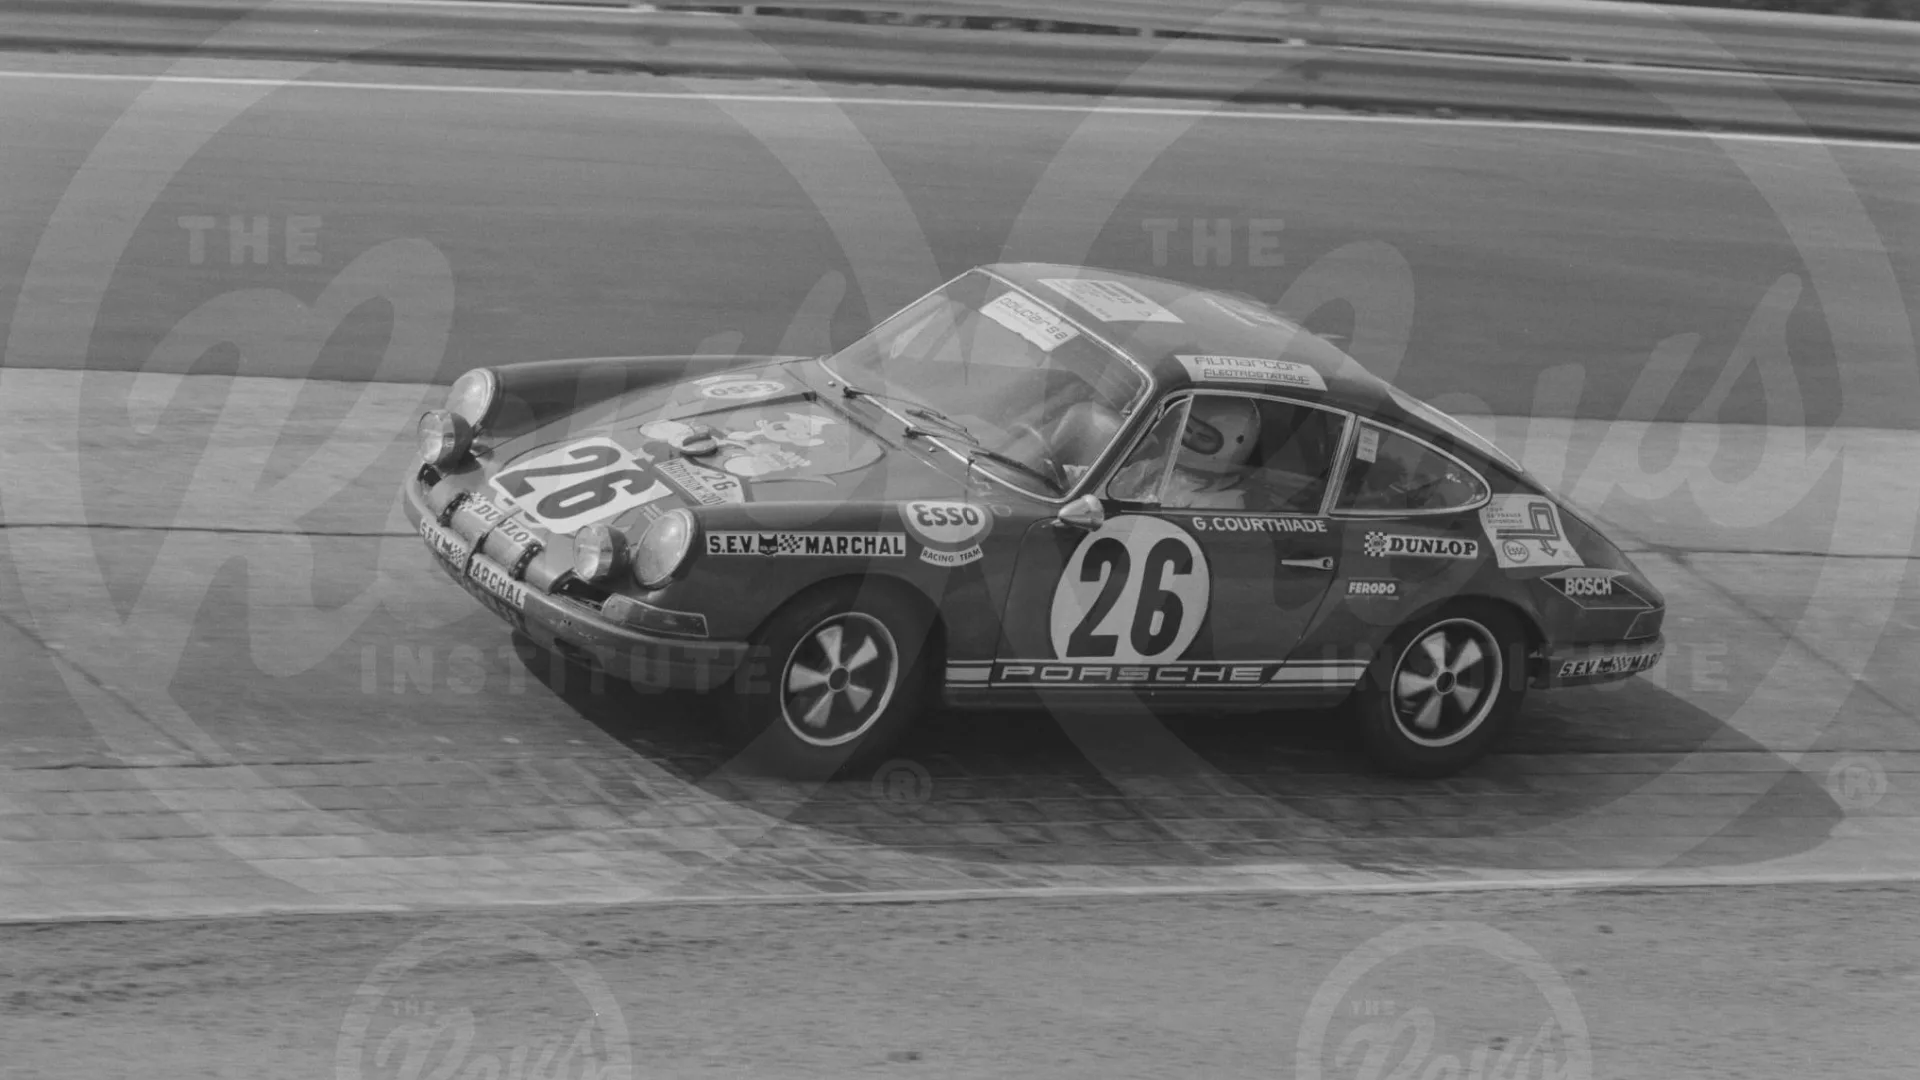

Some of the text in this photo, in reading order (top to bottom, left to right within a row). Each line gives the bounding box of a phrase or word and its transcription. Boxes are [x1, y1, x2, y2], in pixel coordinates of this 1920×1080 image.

[495, 445, 656, 520] 26
[704, 470, 738, 493] 26
[474, 503, 534, 545] DULO
[1192, 516, 1328, 533] G.COURTHIADE
[804, 535, 904, 555] MARCHAL
[1389, 536, 1477, 556] DUNLOP
[922, 548, 981, 564] RACING TEAM
[470, 558, 525, 608] ARCHAL
[1349, 581, 1396, 595] FERODO
[1564, 577, 1612, 596] BOSCH
[1065, 536, 1194, 657] 26
[1000, 665, 1263, 682] PORSCHE
